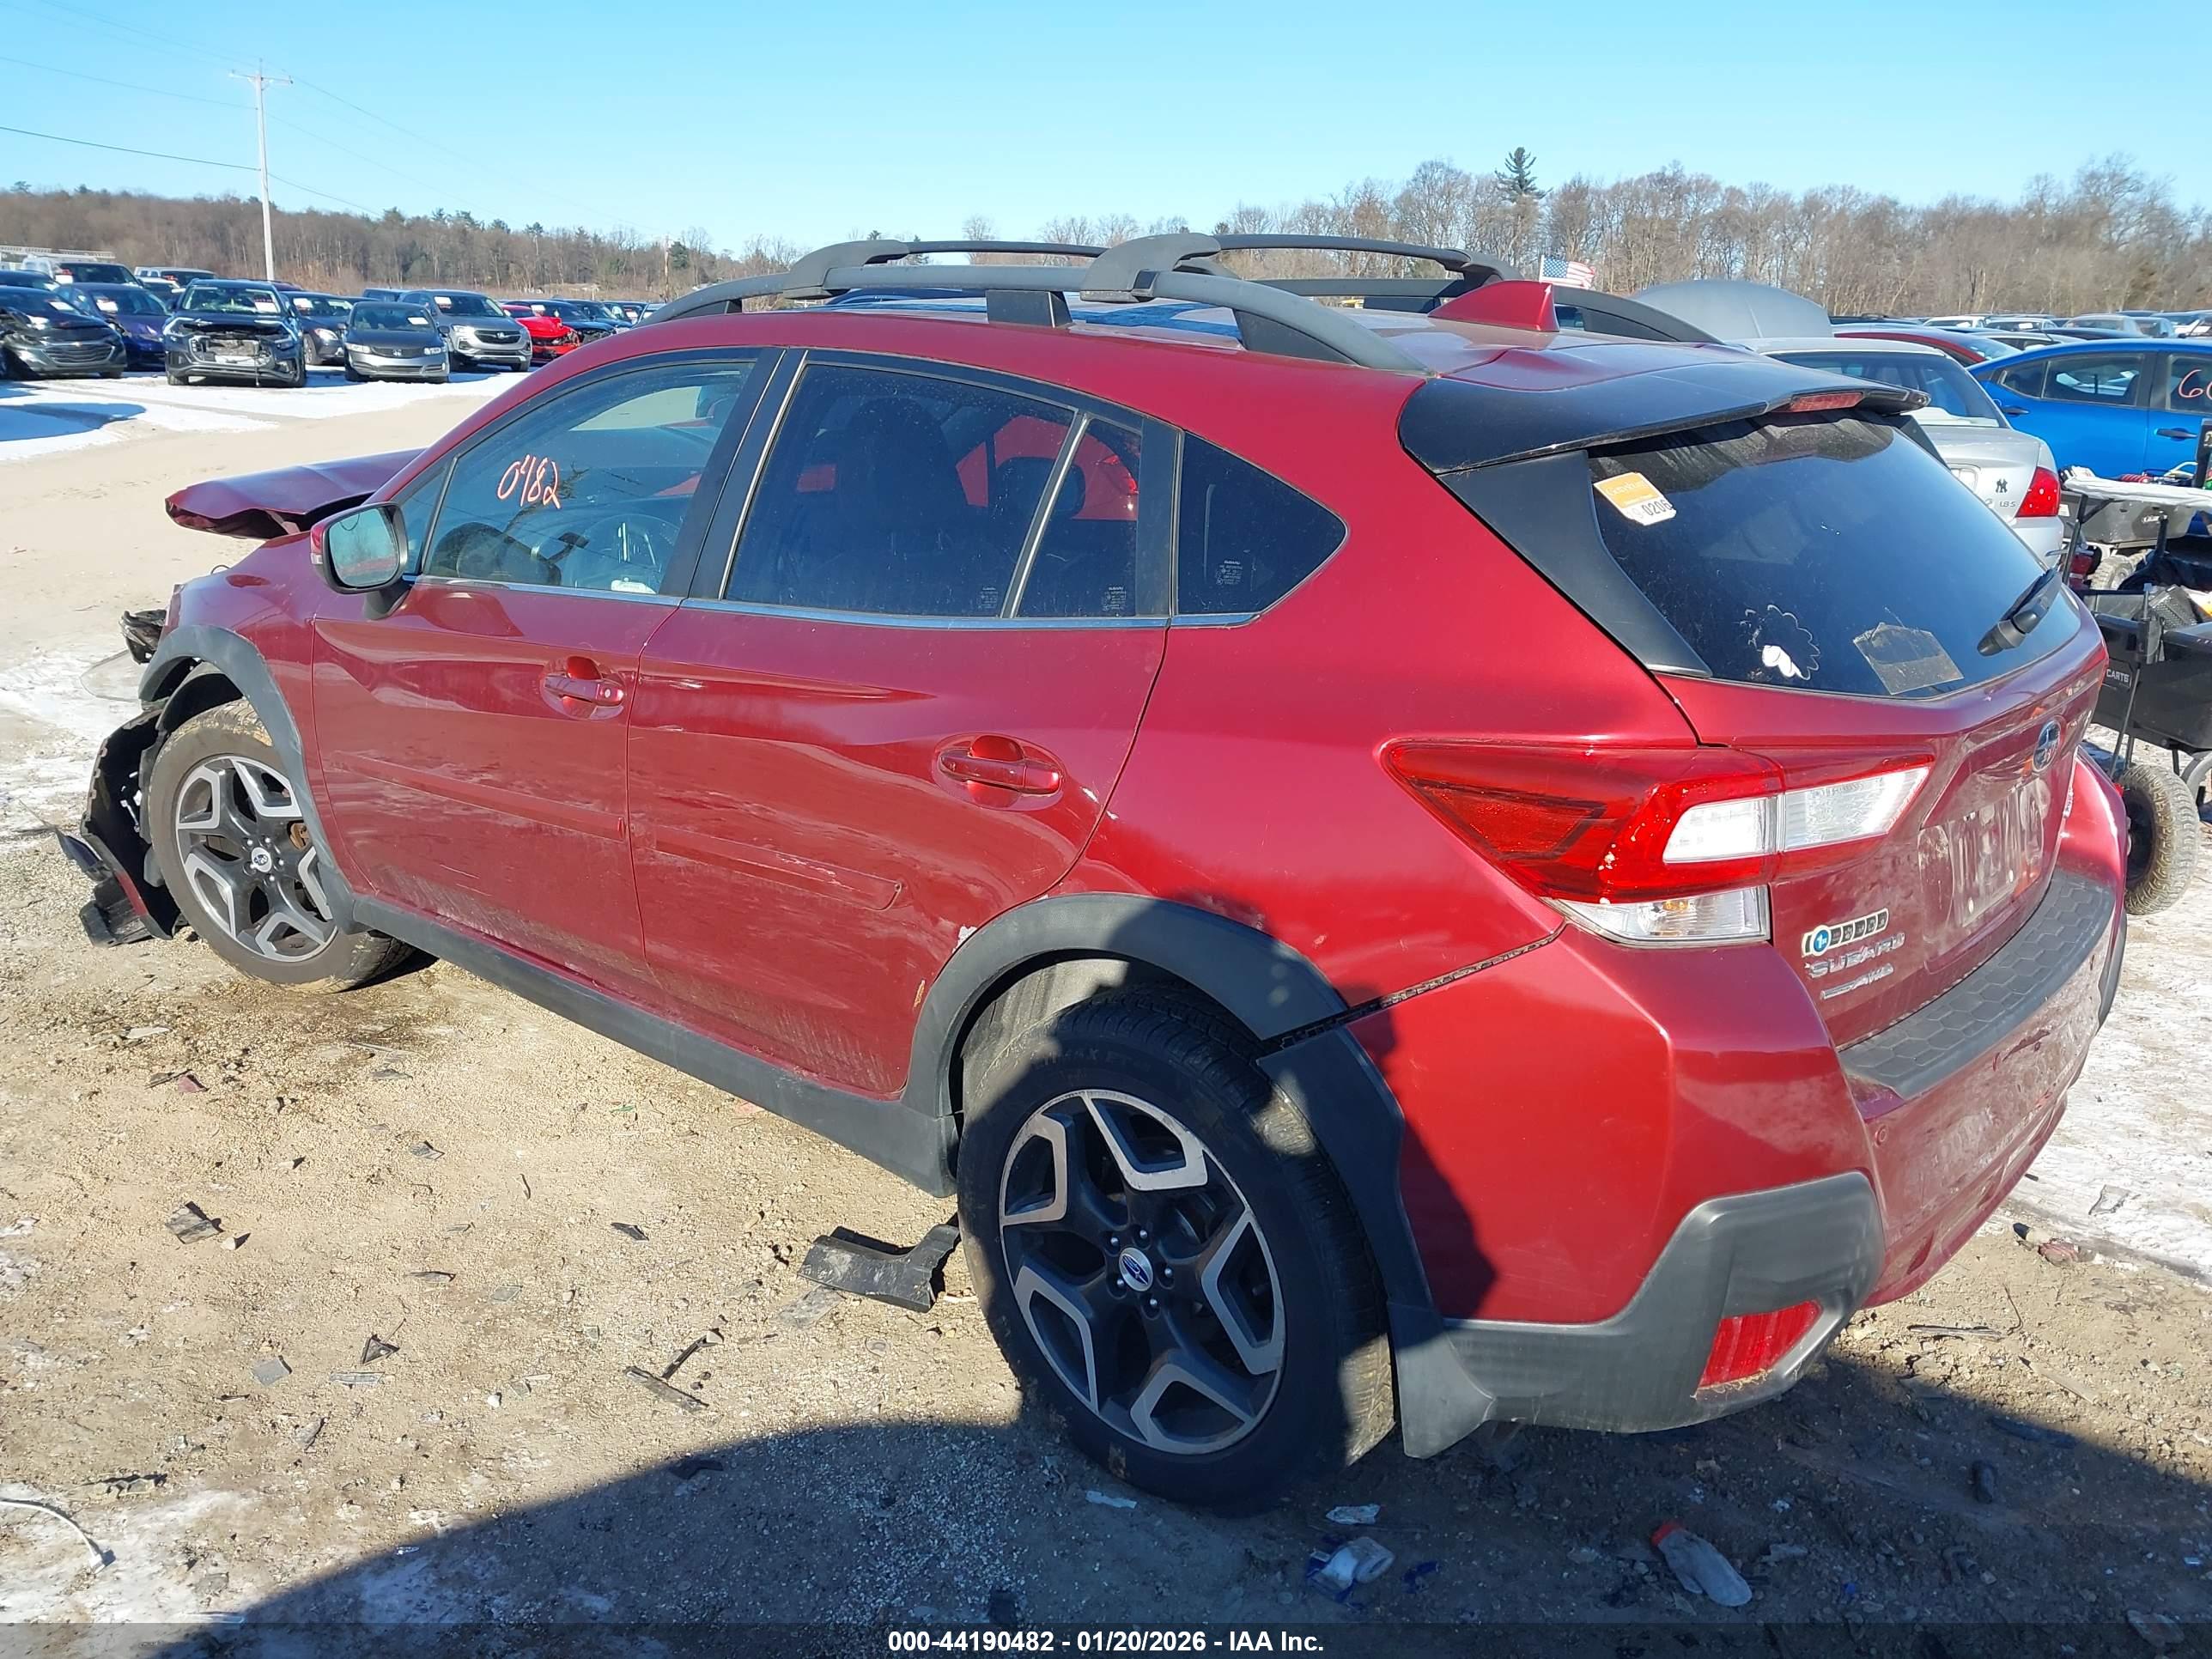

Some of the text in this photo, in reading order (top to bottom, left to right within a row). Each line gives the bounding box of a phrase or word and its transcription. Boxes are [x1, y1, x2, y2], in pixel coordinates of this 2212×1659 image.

[2179, 368, 2212, 399] 6
[497, 454, 561, 509] 0482
[1808, 933, 1905, 978] SUBARU
